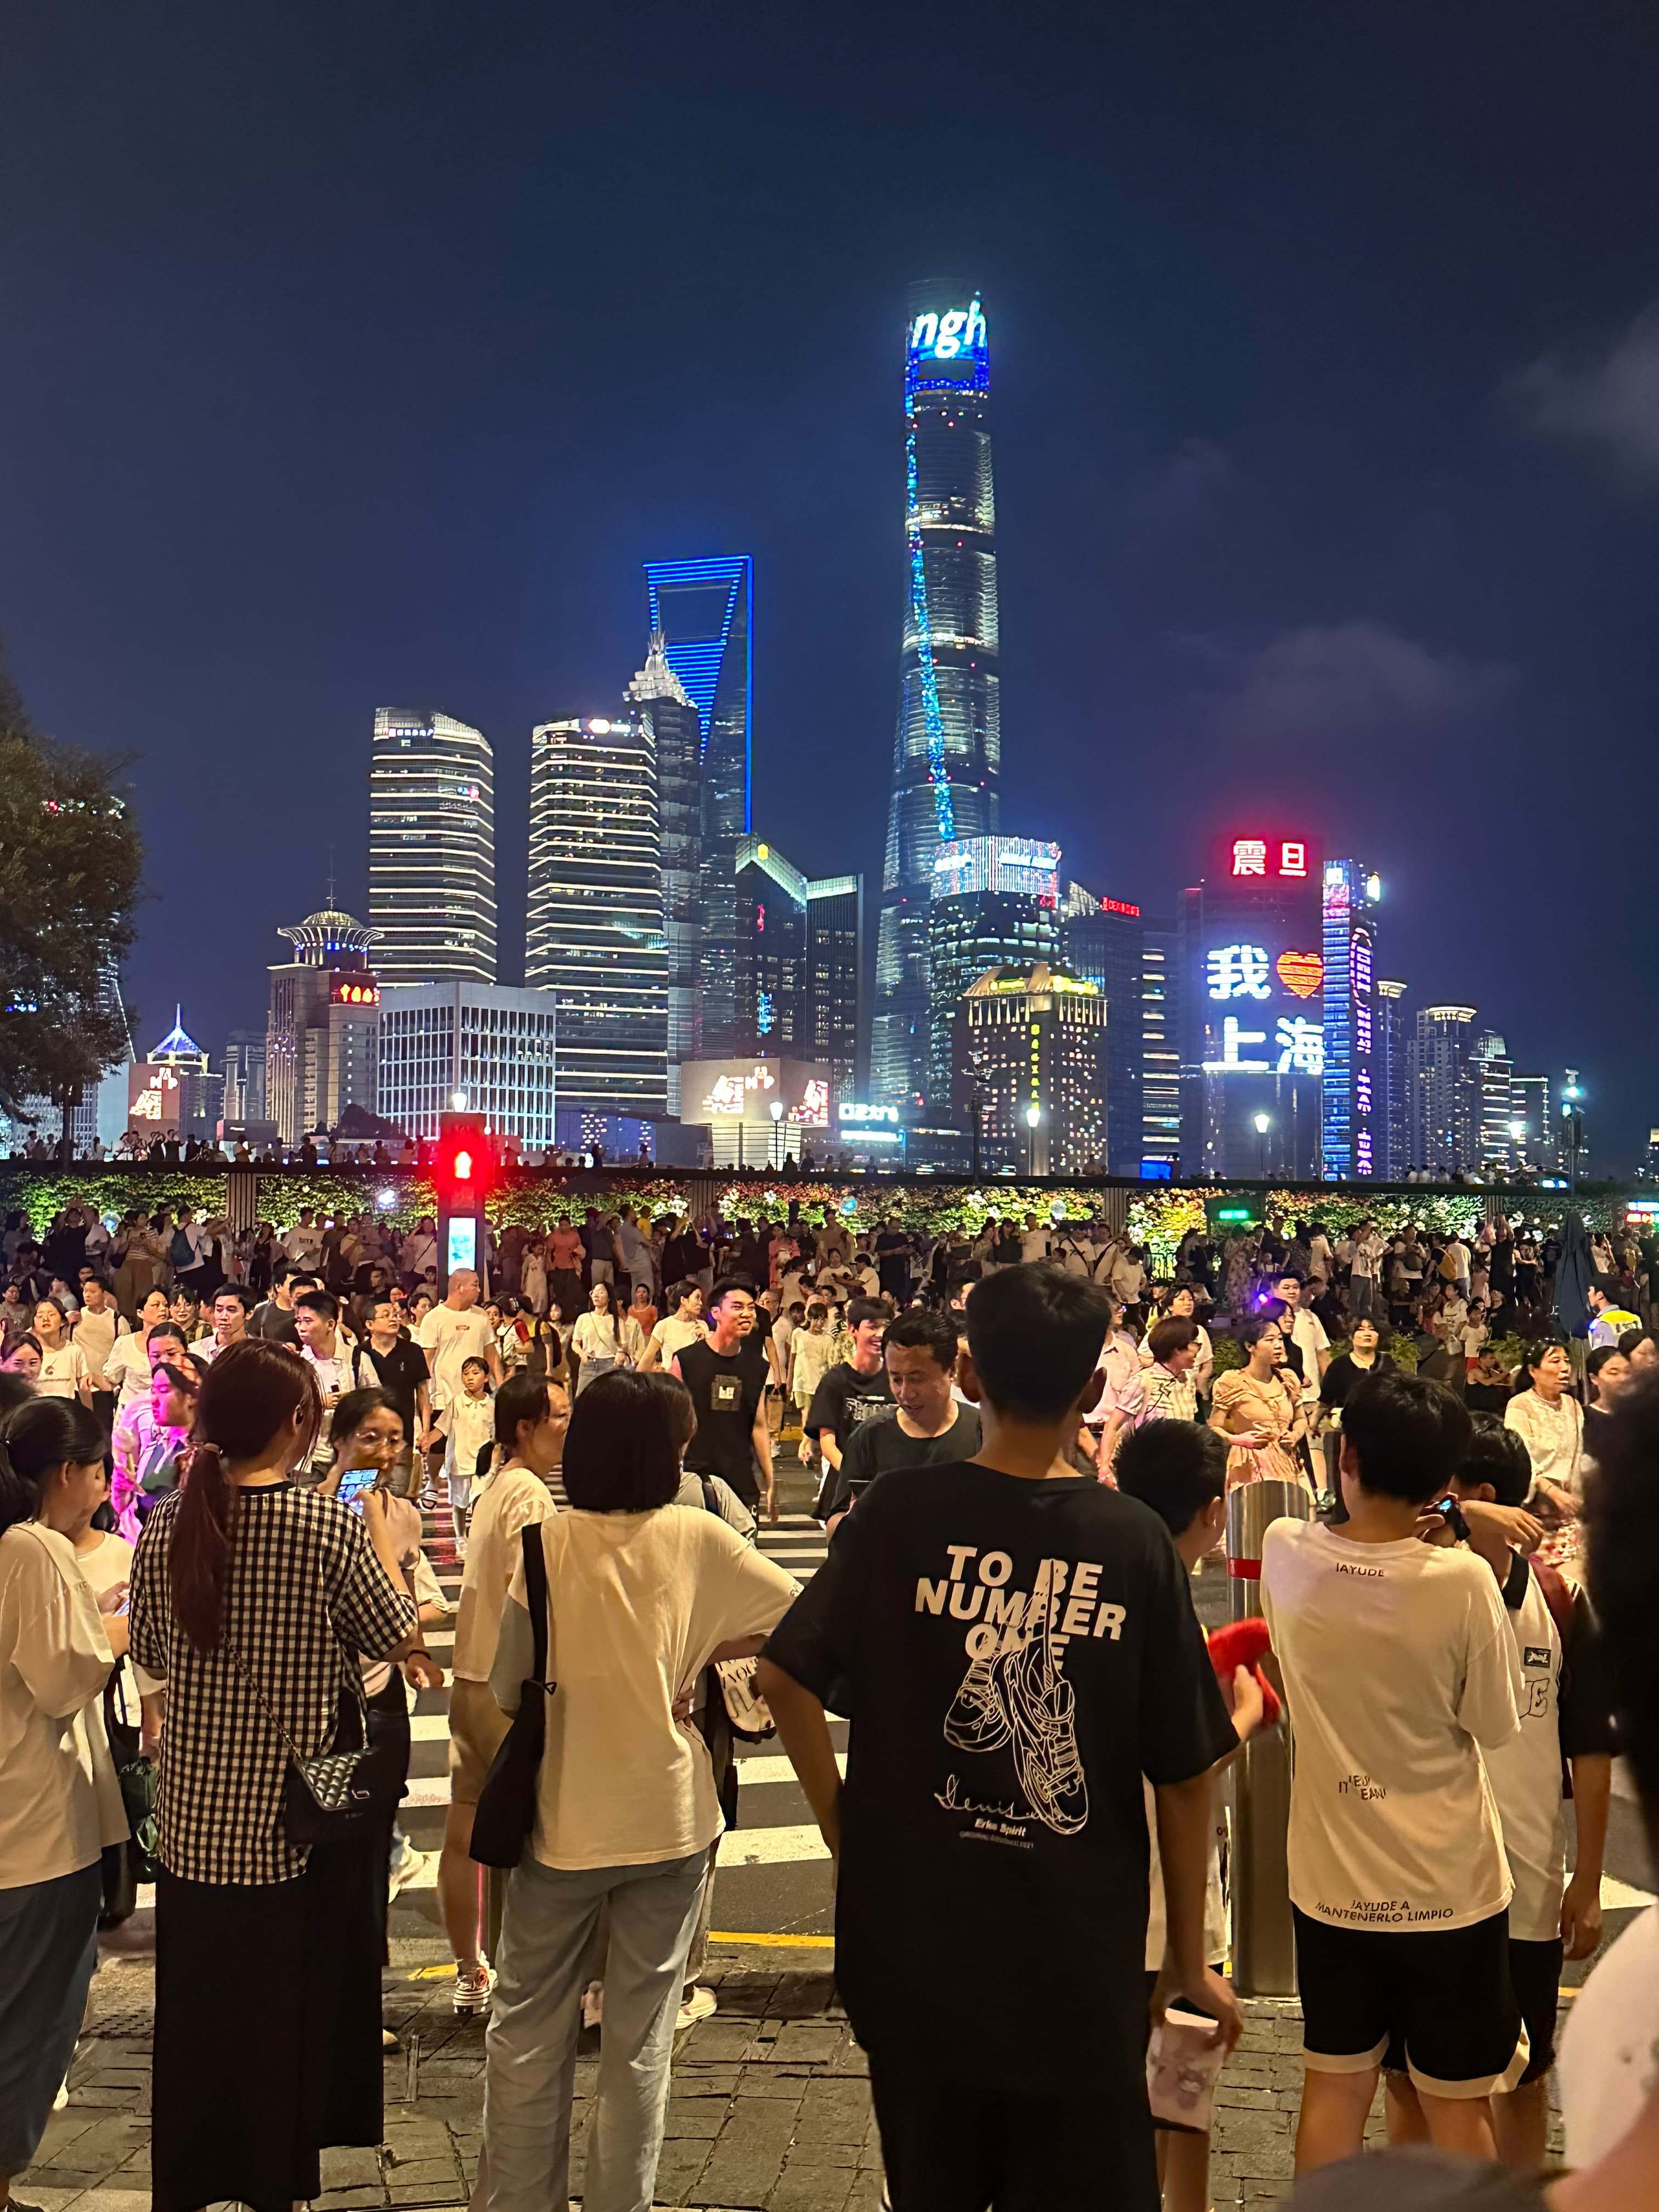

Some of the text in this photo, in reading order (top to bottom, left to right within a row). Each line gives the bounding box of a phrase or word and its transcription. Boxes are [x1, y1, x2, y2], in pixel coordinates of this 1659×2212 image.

[1232, 840, 1307, 877] 震旦
[1206, 945, 1272, 1000] 我
[1201, 1015, 1325, 1076] 上海
[947, 1545, 1103, 1599] TO BE
[915, 1577, 1126, 1640] NUMBER
[1315, 1901, 1453, 1923] MANTENERLO LIMPIO
[1400, 1900, 1410, 1910] A
